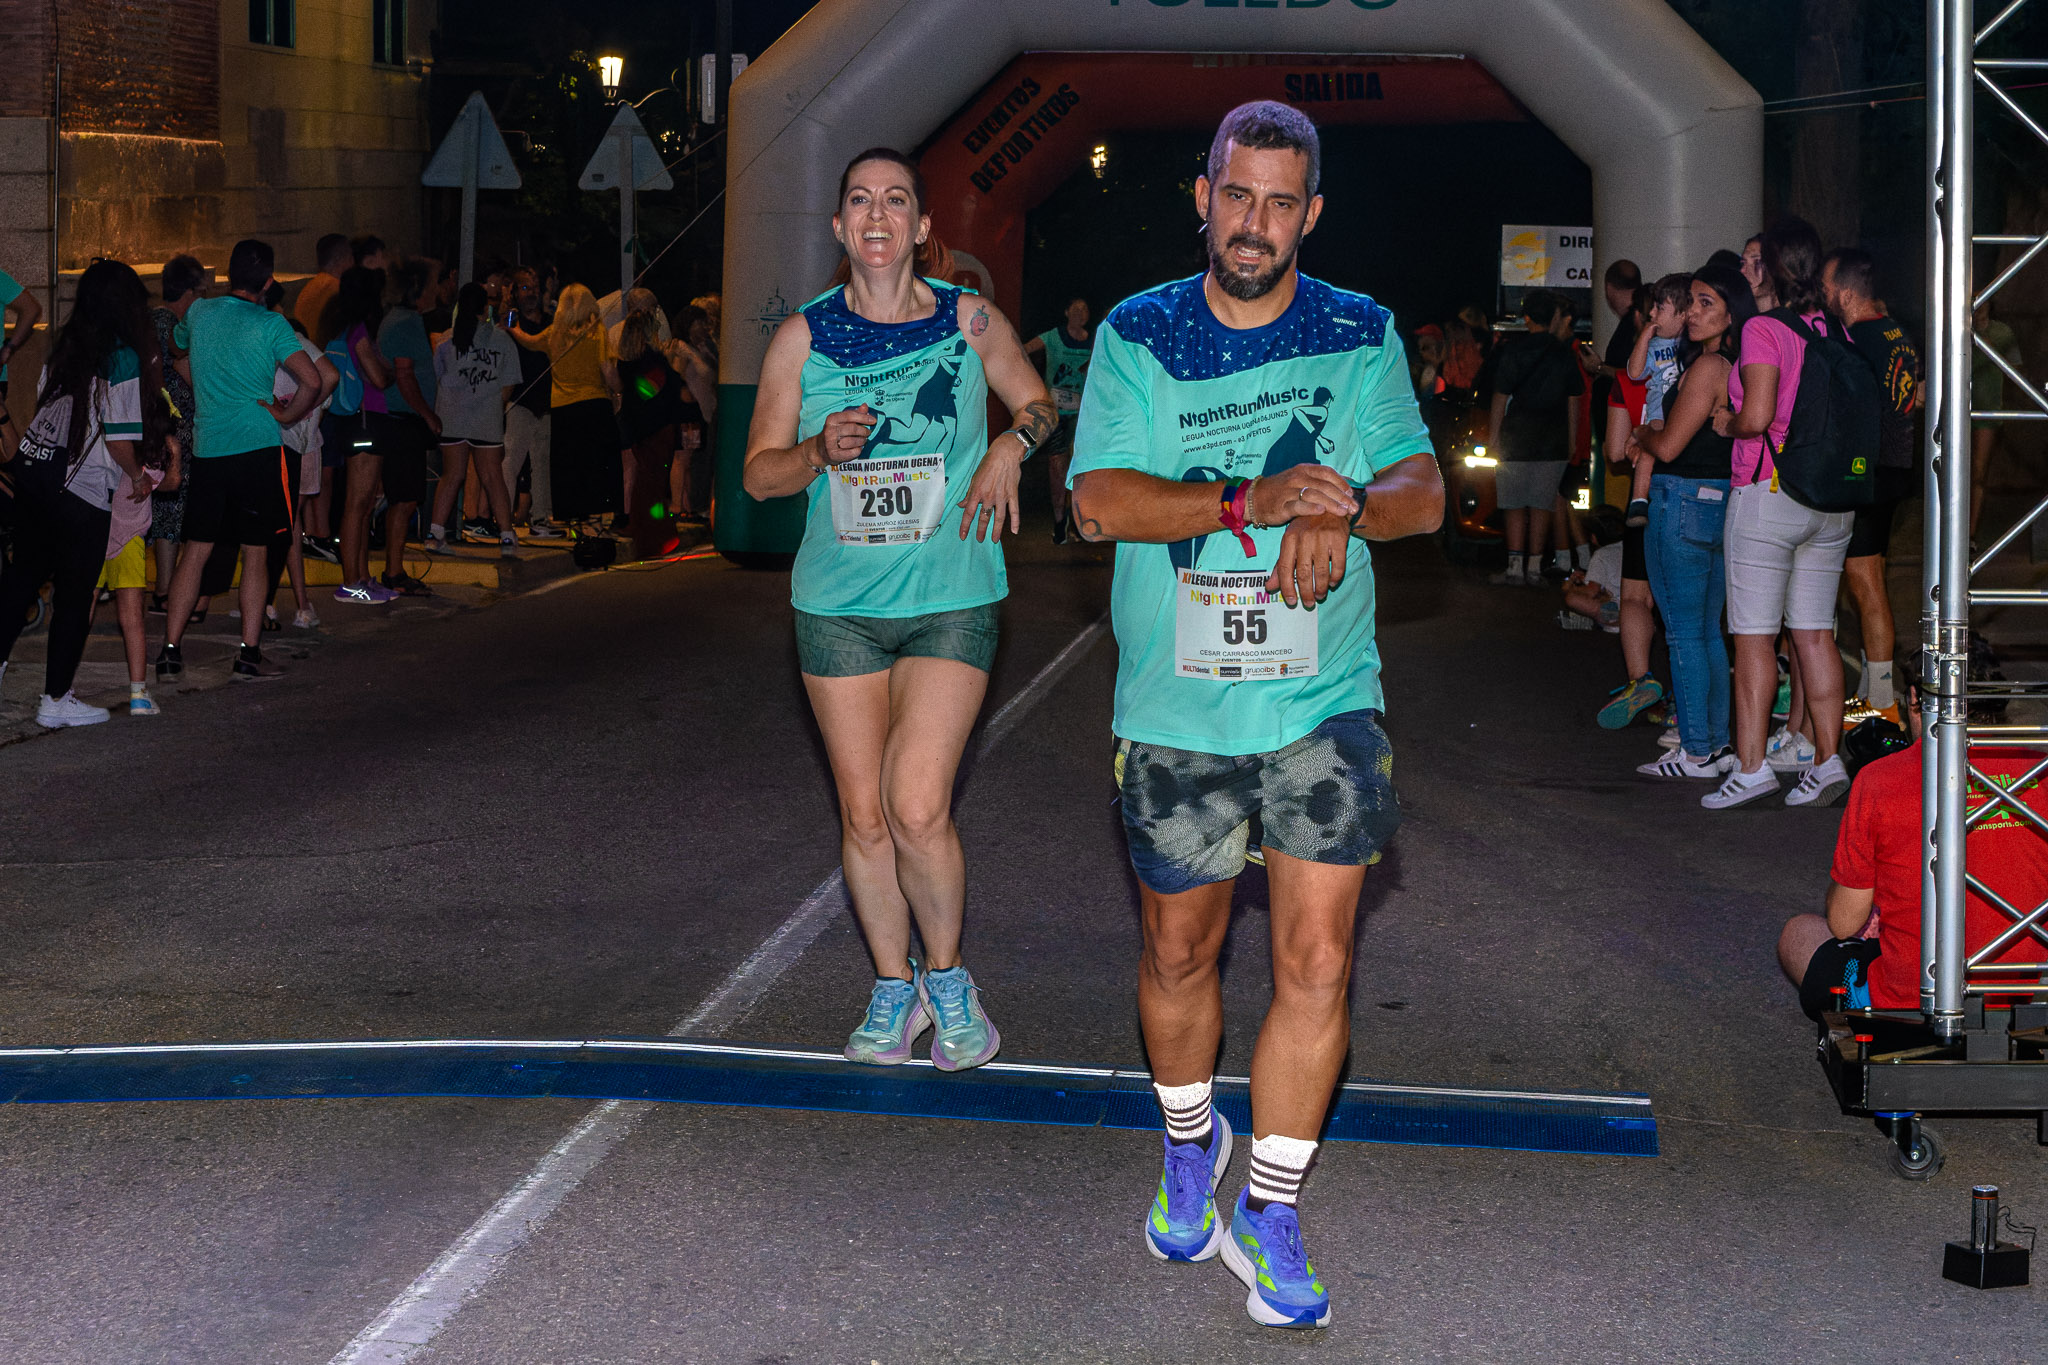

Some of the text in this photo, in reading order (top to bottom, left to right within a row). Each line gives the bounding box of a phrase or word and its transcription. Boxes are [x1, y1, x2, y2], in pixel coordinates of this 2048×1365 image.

[1285, 73, 1384, 102] SALIDA
[962, 77, 1040, 154] EVENTOS
[1566, 268, 1593, 280] CA
[1179, 386, 1309, 428] NightRunMusic
[1182, 433, 1205, 443] LEGUA
[1206, 425, 1241, 437] NOCTURNA
[1184, 440, 1233, 454] www.e3pd.com
[839, 462, 863, 472] LEGUA
[864, 459, 910, 472] NOCTURNA
[911, 457, 938, 468] UGENA
[841, 471, 931, 487] NightRunMusic
[860, 486, 913, 518] 230
[1191, 573, 1219, 587] LEGUA
[1220, 575, 1270, 588] NOCTURN
[1190, 590, 1284, 606] NightRunMus
[1223, 610, 1268, 645] 55
